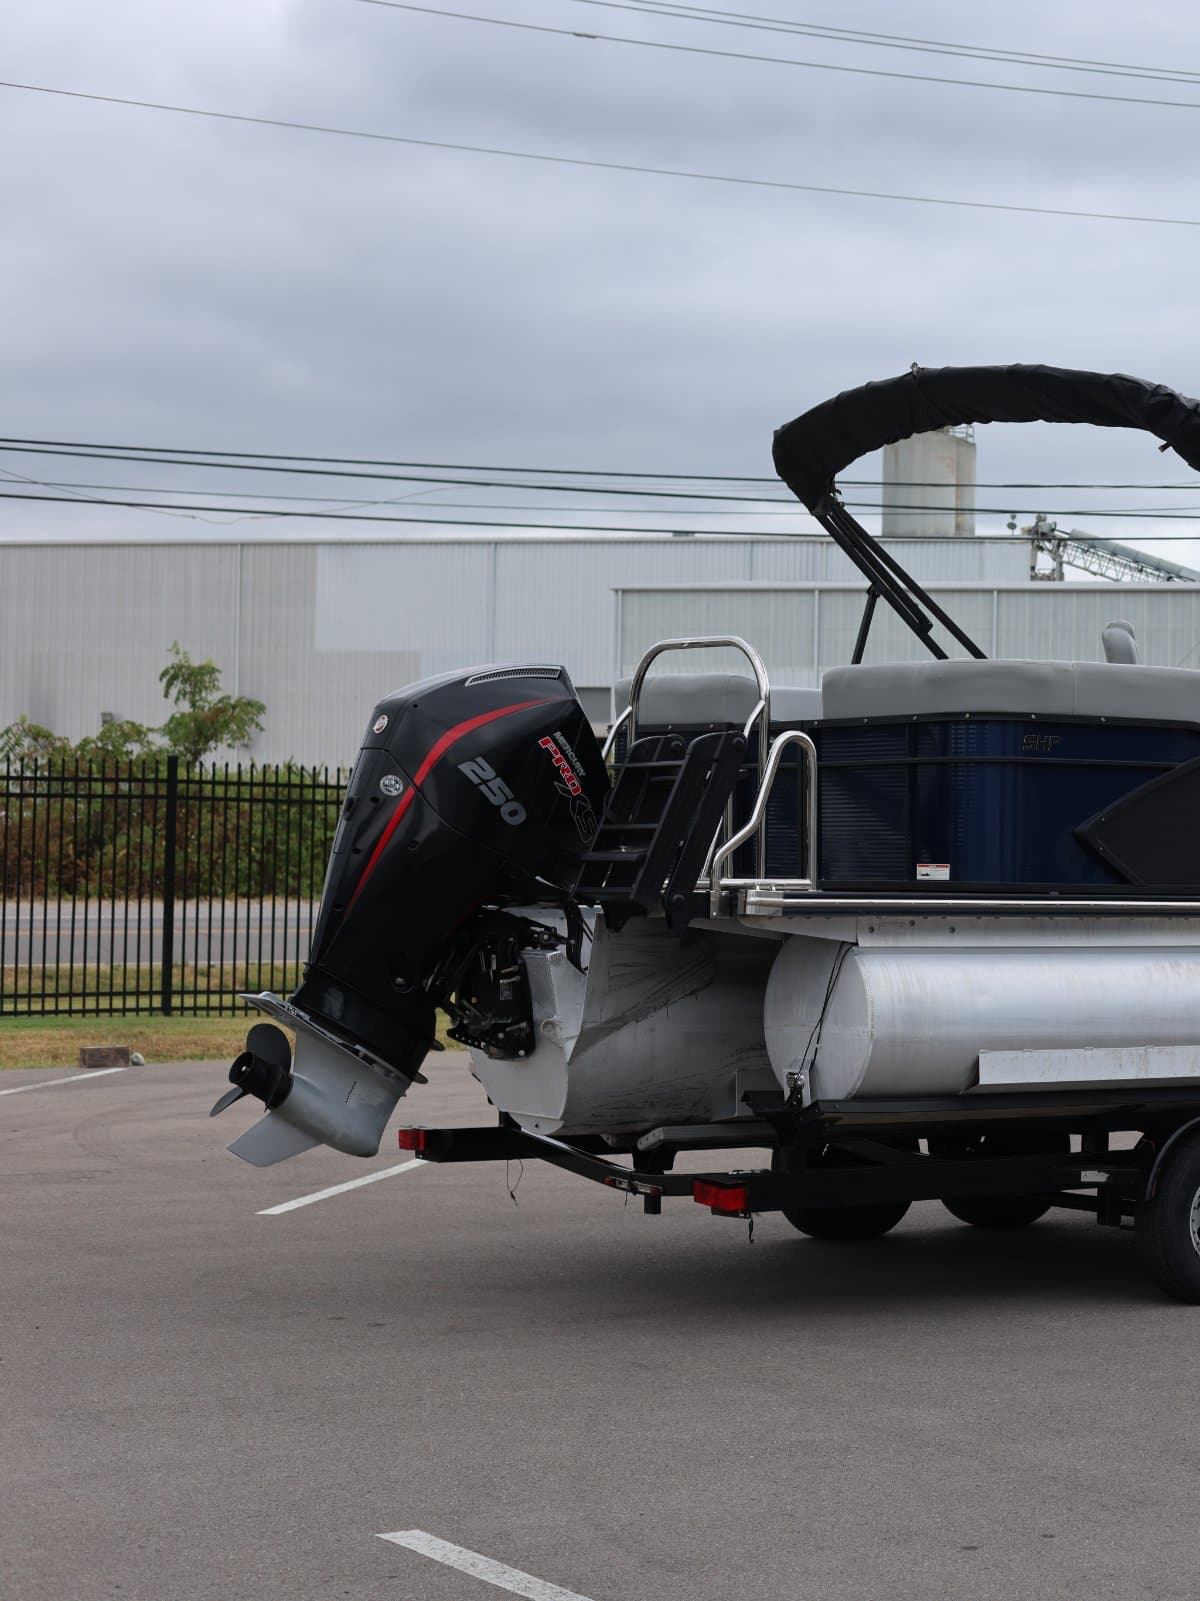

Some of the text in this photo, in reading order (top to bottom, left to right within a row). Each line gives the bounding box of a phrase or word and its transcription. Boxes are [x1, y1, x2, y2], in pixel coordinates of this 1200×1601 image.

[538, 736, 582, 797] PRO
[553, 731, 586, 777] MERCURY
[1022, 734, 1062, 752] SHP
[457, 756, 527, 826] 250
